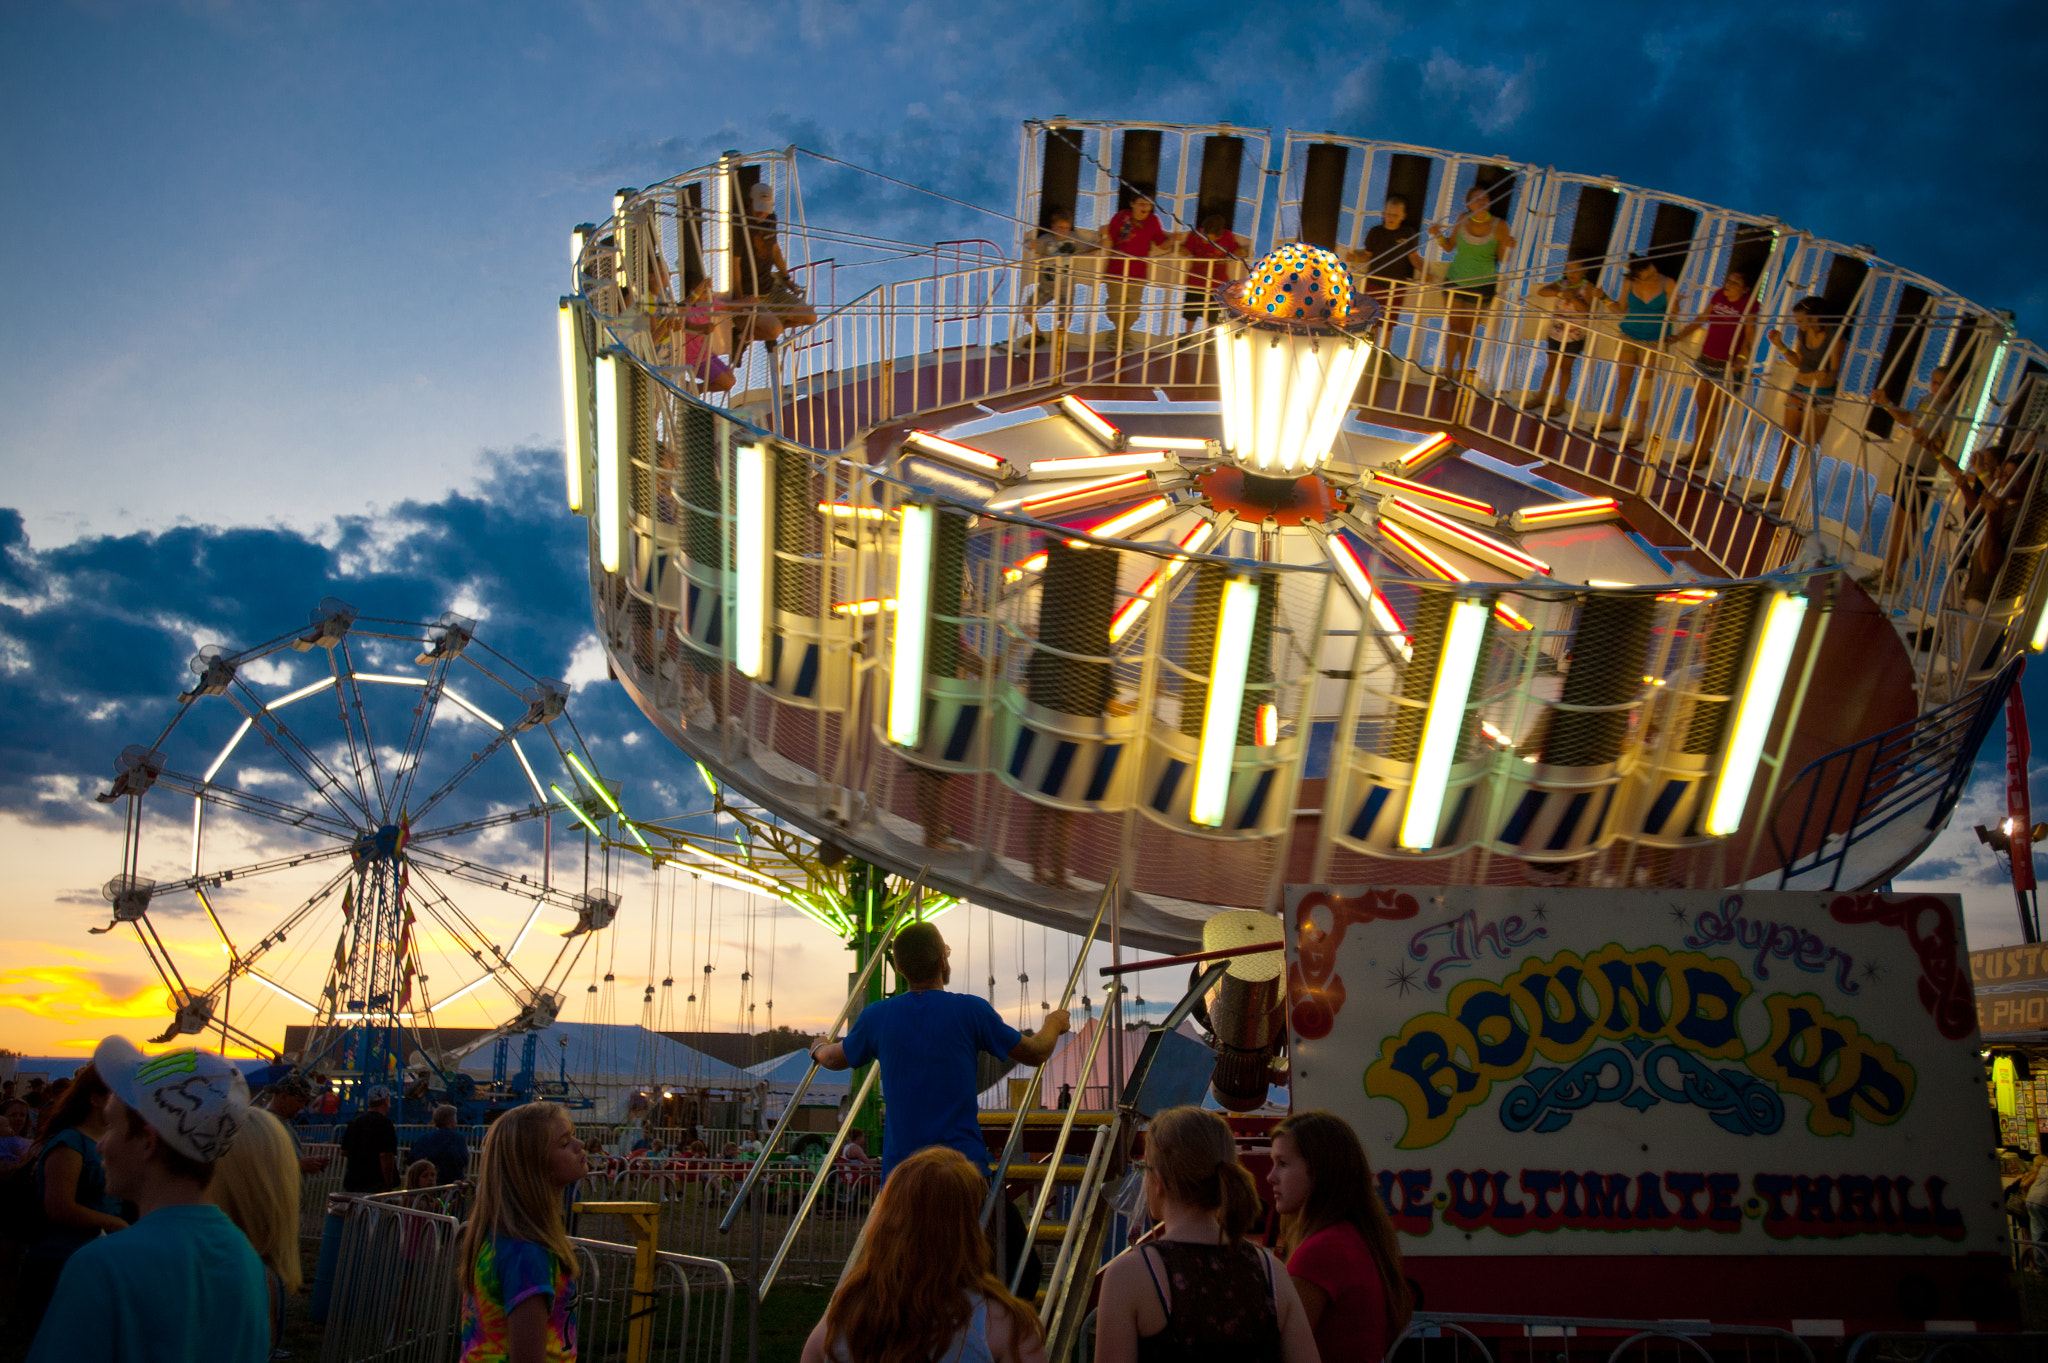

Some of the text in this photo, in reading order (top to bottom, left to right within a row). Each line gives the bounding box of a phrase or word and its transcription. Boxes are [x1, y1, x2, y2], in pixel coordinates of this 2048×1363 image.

[1409, 894, 1860, 995] The Super
[1375, 948, 1914, 1143] ROUND UP
[1993, 997, 2048, 1026] PHO
[1443, 1169, 1742, 1236] ULTIMATE
[1755, 1173, 1966, 1239] THRILL
